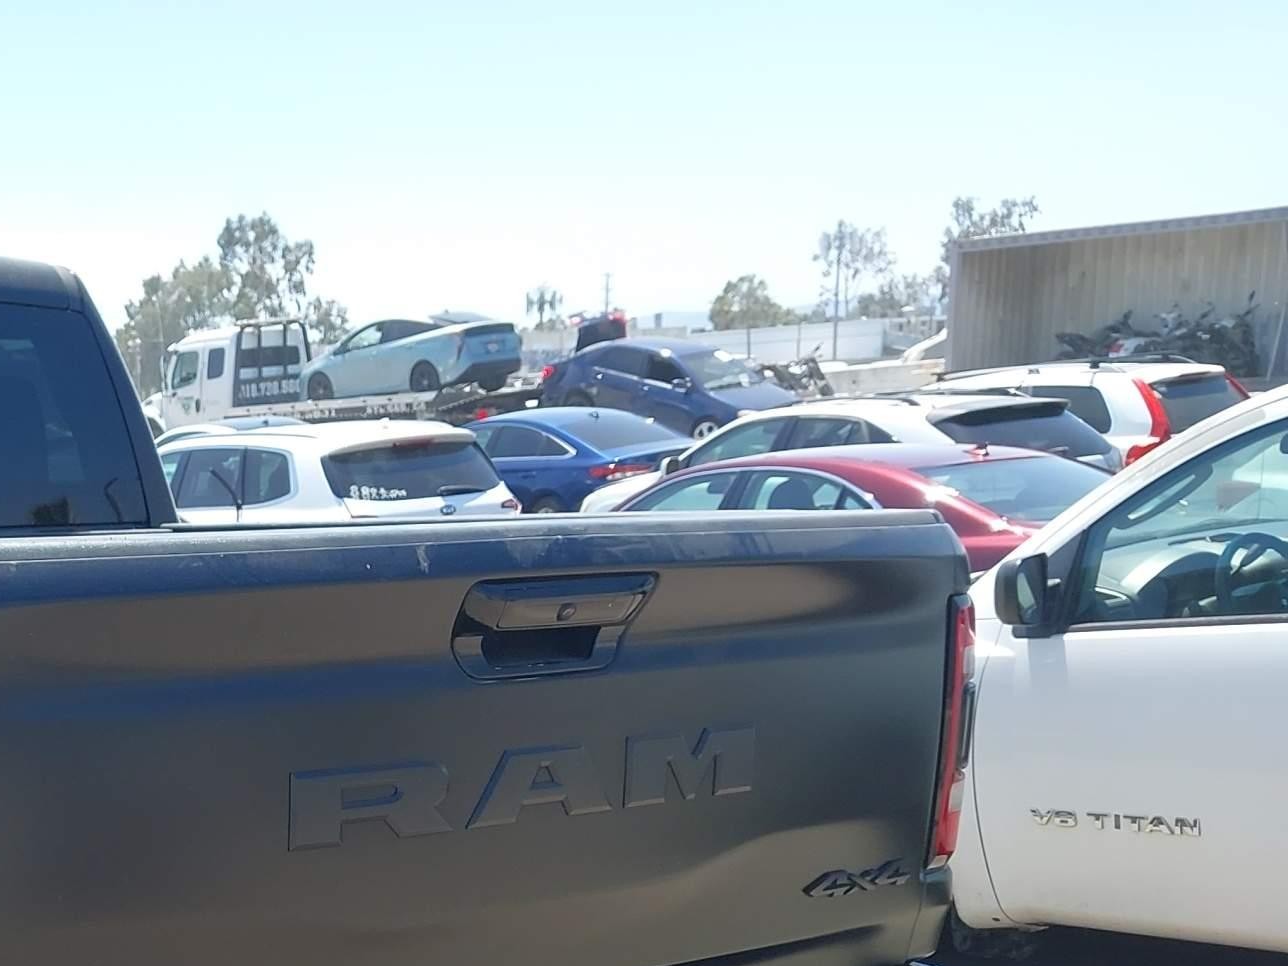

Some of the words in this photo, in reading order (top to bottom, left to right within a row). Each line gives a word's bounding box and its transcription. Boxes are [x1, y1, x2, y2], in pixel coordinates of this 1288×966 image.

[287, 725, 757, 852] RAM
[1029, 808, 1079, 829] V8
[1086, 811, 1202, 837] TITAN
